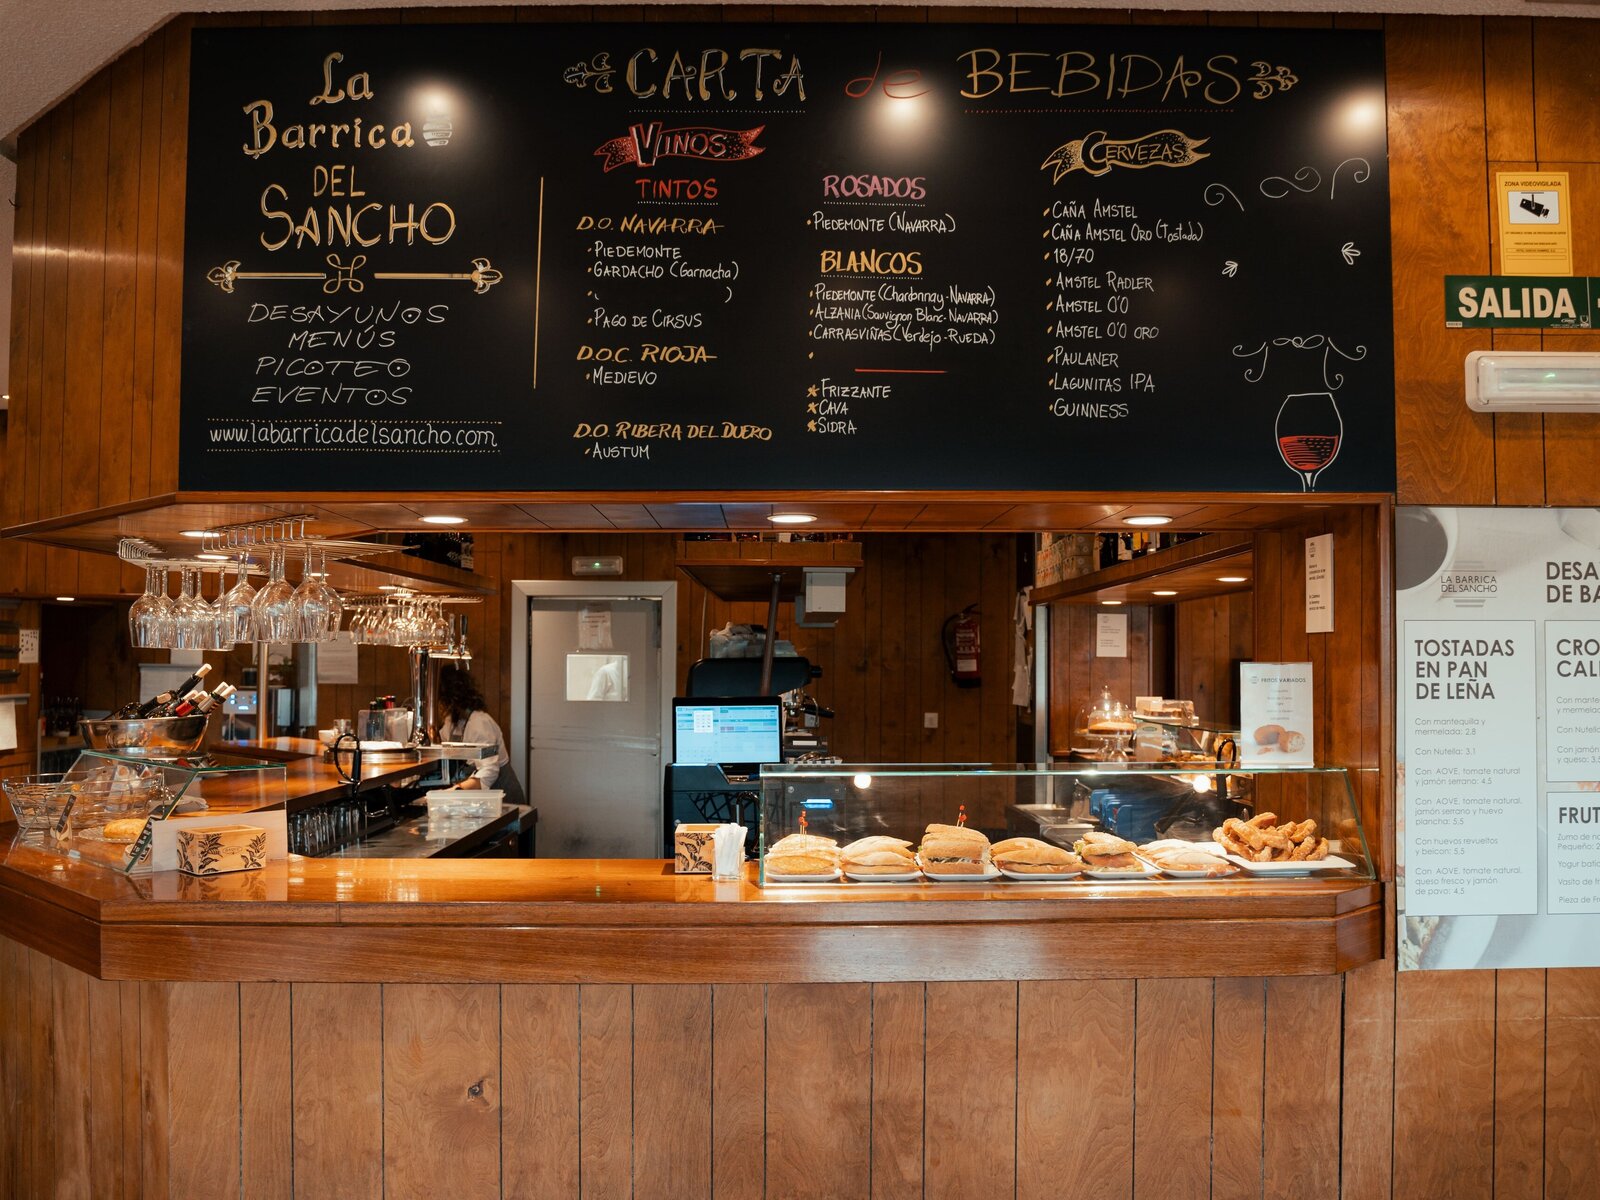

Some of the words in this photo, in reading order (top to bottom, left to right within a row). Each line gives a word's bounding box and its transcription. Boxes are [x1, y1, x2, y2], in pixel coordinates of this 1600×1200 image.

[310, 52, 374, 105] La
[626, 48, 807, 101] CARTA
[844, 51, 937, 99] de
[957, 48, 1240, 104] BEBIDAS
[243, 99, 415, 159] Barrica
[313, 165, 366, 197] DEL
[635, 177, 719, 200] TINTOS
[822, 174, 926, 200] ROSADOS
[576, 216, 614, 231] D.O.
[620, 213, 725, 235] NAVARRA
[1156, 219, 1204, 243] (Tostada)
[820, 249, 923, 275] BLANCOS
[1053, 247, 1095, 267] 18/70
[669, 261, 739, 280] (Garnacha)
[248, 300, 448, 324] DESAYUNOS
[1458, 286, 1577, 319] SALIDA
[632, 316, 648, 328] DE
[288, 325, 396, 350] MENÚS
[641, 343, 718, 364] RIOJA
[255, 356, 410, 377] PICOTEO
[1130, 373, 1155, 393] IPA
[251, 383, 412, 406] EVENTOS
[209, 422, 497, 447] www.labarricadelsancho.com
[573, 423, 610, 438] D.O.
[615, 421, 683, 440] RIBERA
[687, 424, 719, 439] DEL
[721, 421, 773, 440] DUERO
[1441, 575, 1453, 584] LA
[1455, 575, 1497, 584] BARRICA
[1441, 584, 1458, 593] DEL
[1458, 584, 1498, 593] SANCHO
[1547, 584, 1573, 603] DE
[1414, 639, 1515, 657] TOSTADAS
[1556, 638, 1600, 656] CRO
[1415, 661, 1440, 678] EN
[1447, 661, 1488, 678] PAN
[1416, 682, 1440, 700] DE
[1447, 678, 1495, 700] LEÑA
[1415, 718, 1431, 726] Con
[1433, 717, 1479, 727] mantequilla
[1556, 726, 1573, 734] Con
[1415, 728, 1463, 736] mermelada:
[1415, 747, 1431, 755] Con
[1433, 747, 1463, 755] Nutella:
[1557, 745, 1573, 753] Con
[1463, 767, 1491, 775] tomate
[1463, 797, 1491, 805] tomate
[1479, 807, 1503, 815] huevo
[1415, 837, 1432, 845] Con
[1415, 867, 1432, 875] Con
[1463, 867, 1491, 875] tomate
